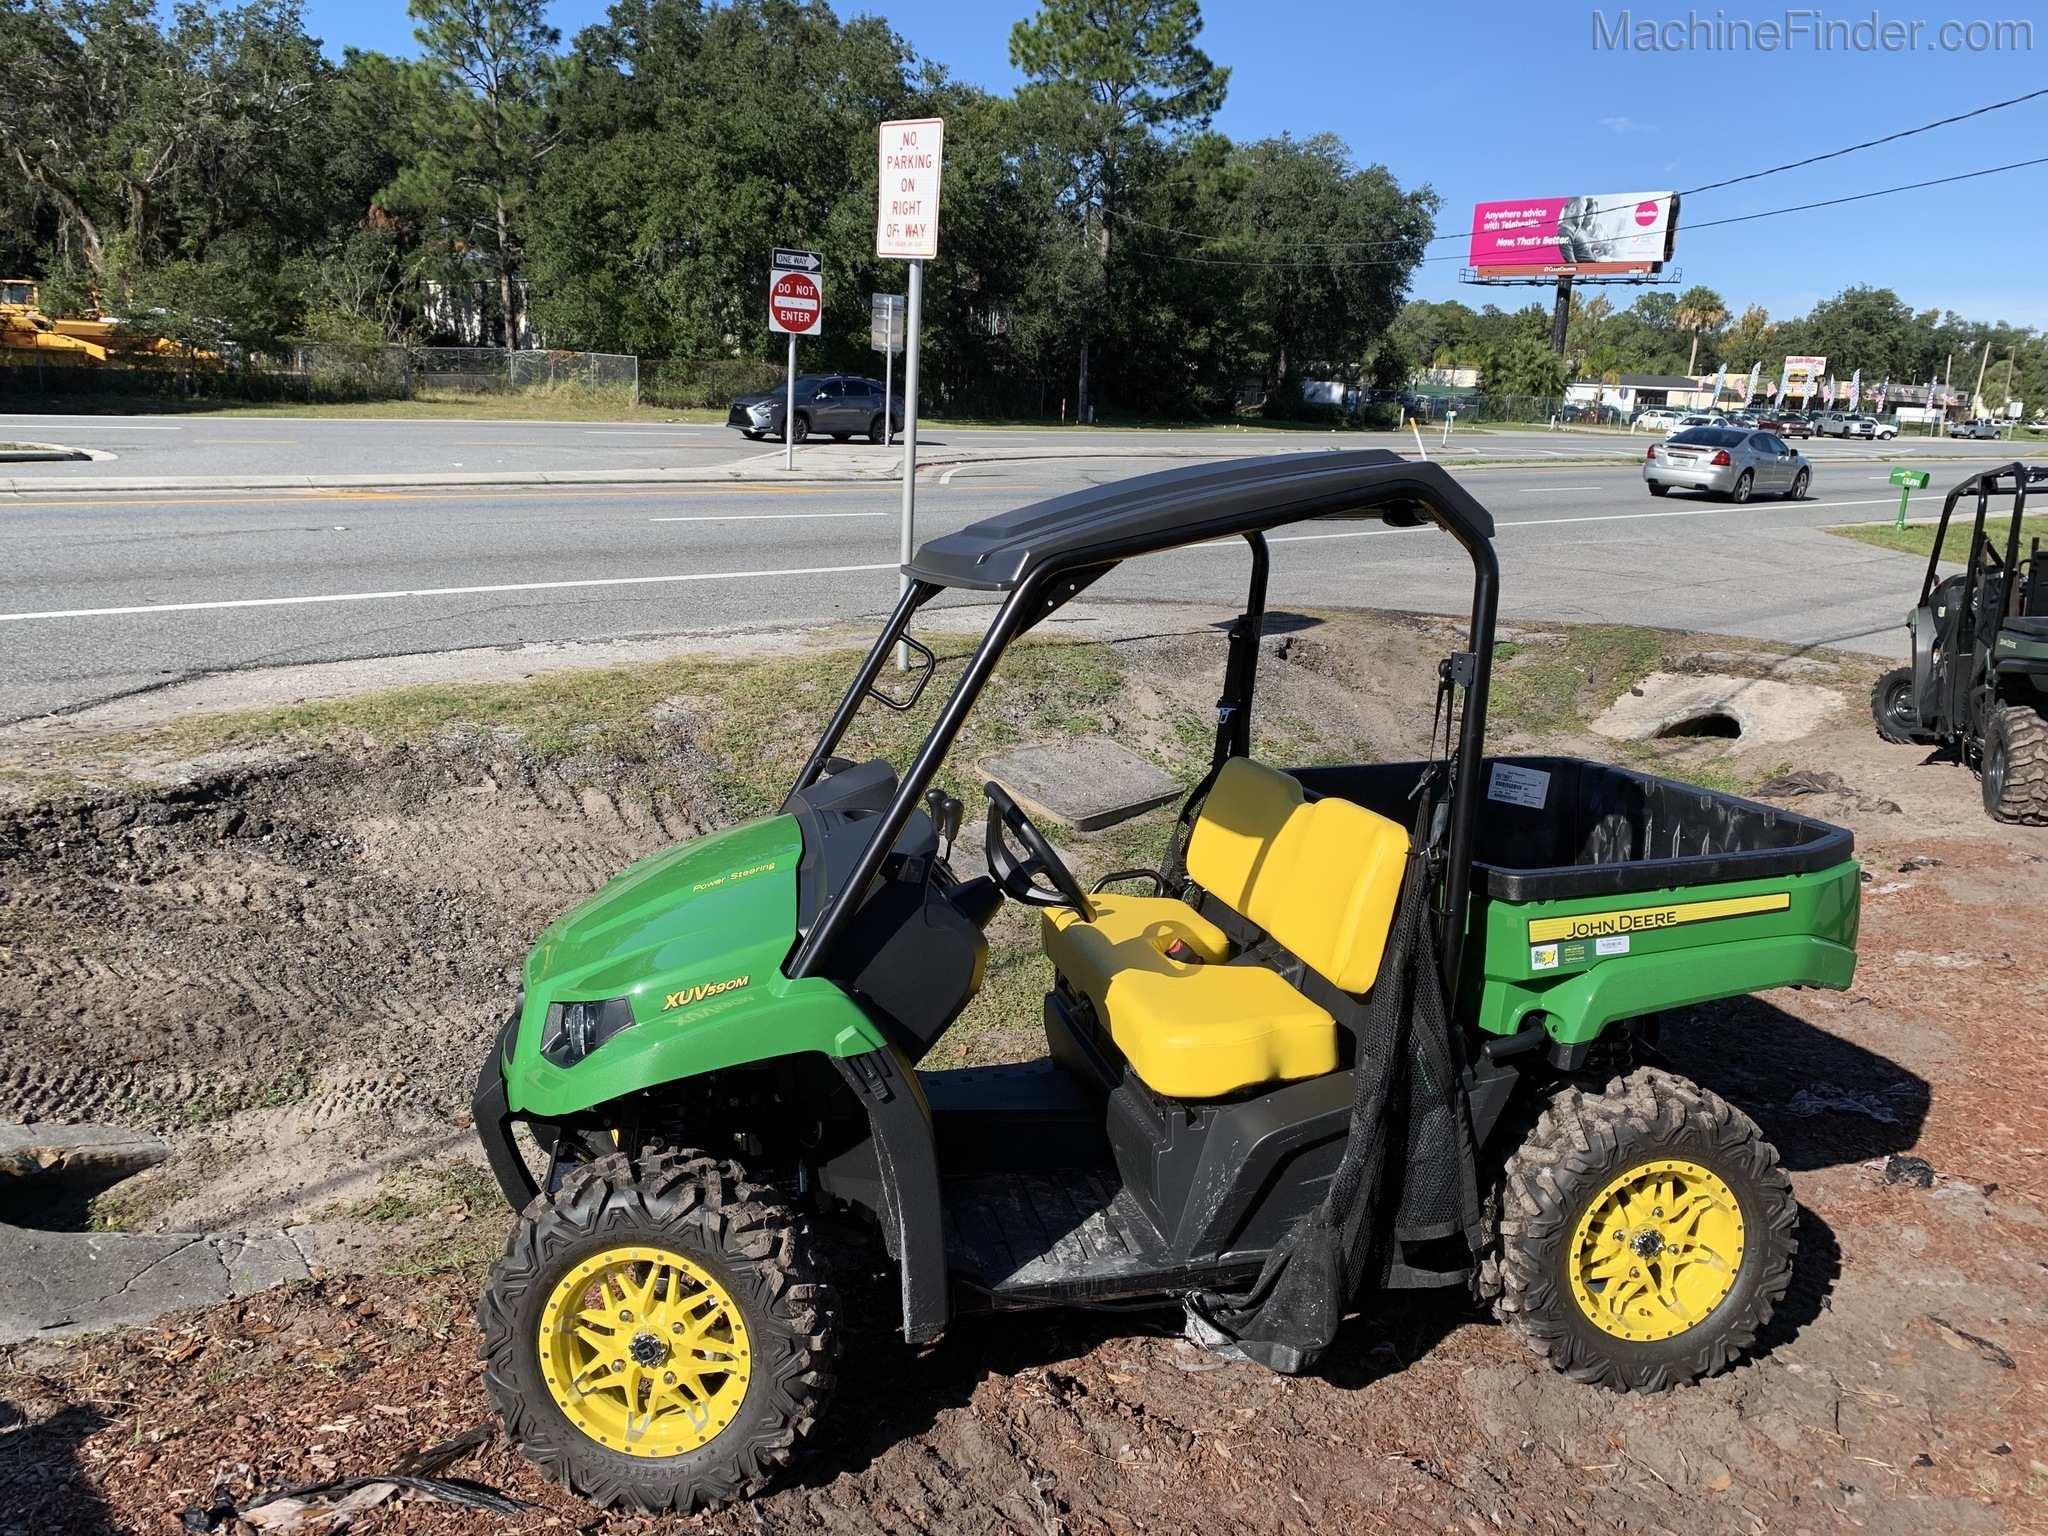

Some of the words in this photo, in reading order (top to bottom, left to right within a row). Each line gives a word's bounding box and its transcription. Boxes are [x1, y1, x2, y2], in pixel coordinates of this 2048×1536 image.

[903, 131, 917, 146] NO
[887, 154, 932, 170] PARKING
[901, 178, 915, 193] ON
[892, 201, 922, 216] RIGHT
[1484, 210, 1521, 220] Anywhere
[1522, 208, 1547, 218] advice
[886, 223, 899, 238] OF
[905, 223, 926, 239] WAY
[1484, 221, 1499, 230] with
[1496, 238, 1515, 247] Now,
[1516, 236, 1540, 246] That's
[1542, 235, 1569, 245] Better.
[778, 255, 792, 264] ONE
[794, 256, 808, 265] WAY
[778, 283, 791, 293] DO
[796, 285, 814, 296] NOT
[781, 310, 811, 322] ENTER
[693, 877, 727, 892] Power
[730, 862, 776, 880] Steering
[1567, 919, 1614, 937] JOHN
[1619, 911, 1677, 930] DEERE
[661, 975, 750, 1012] XUV590M
